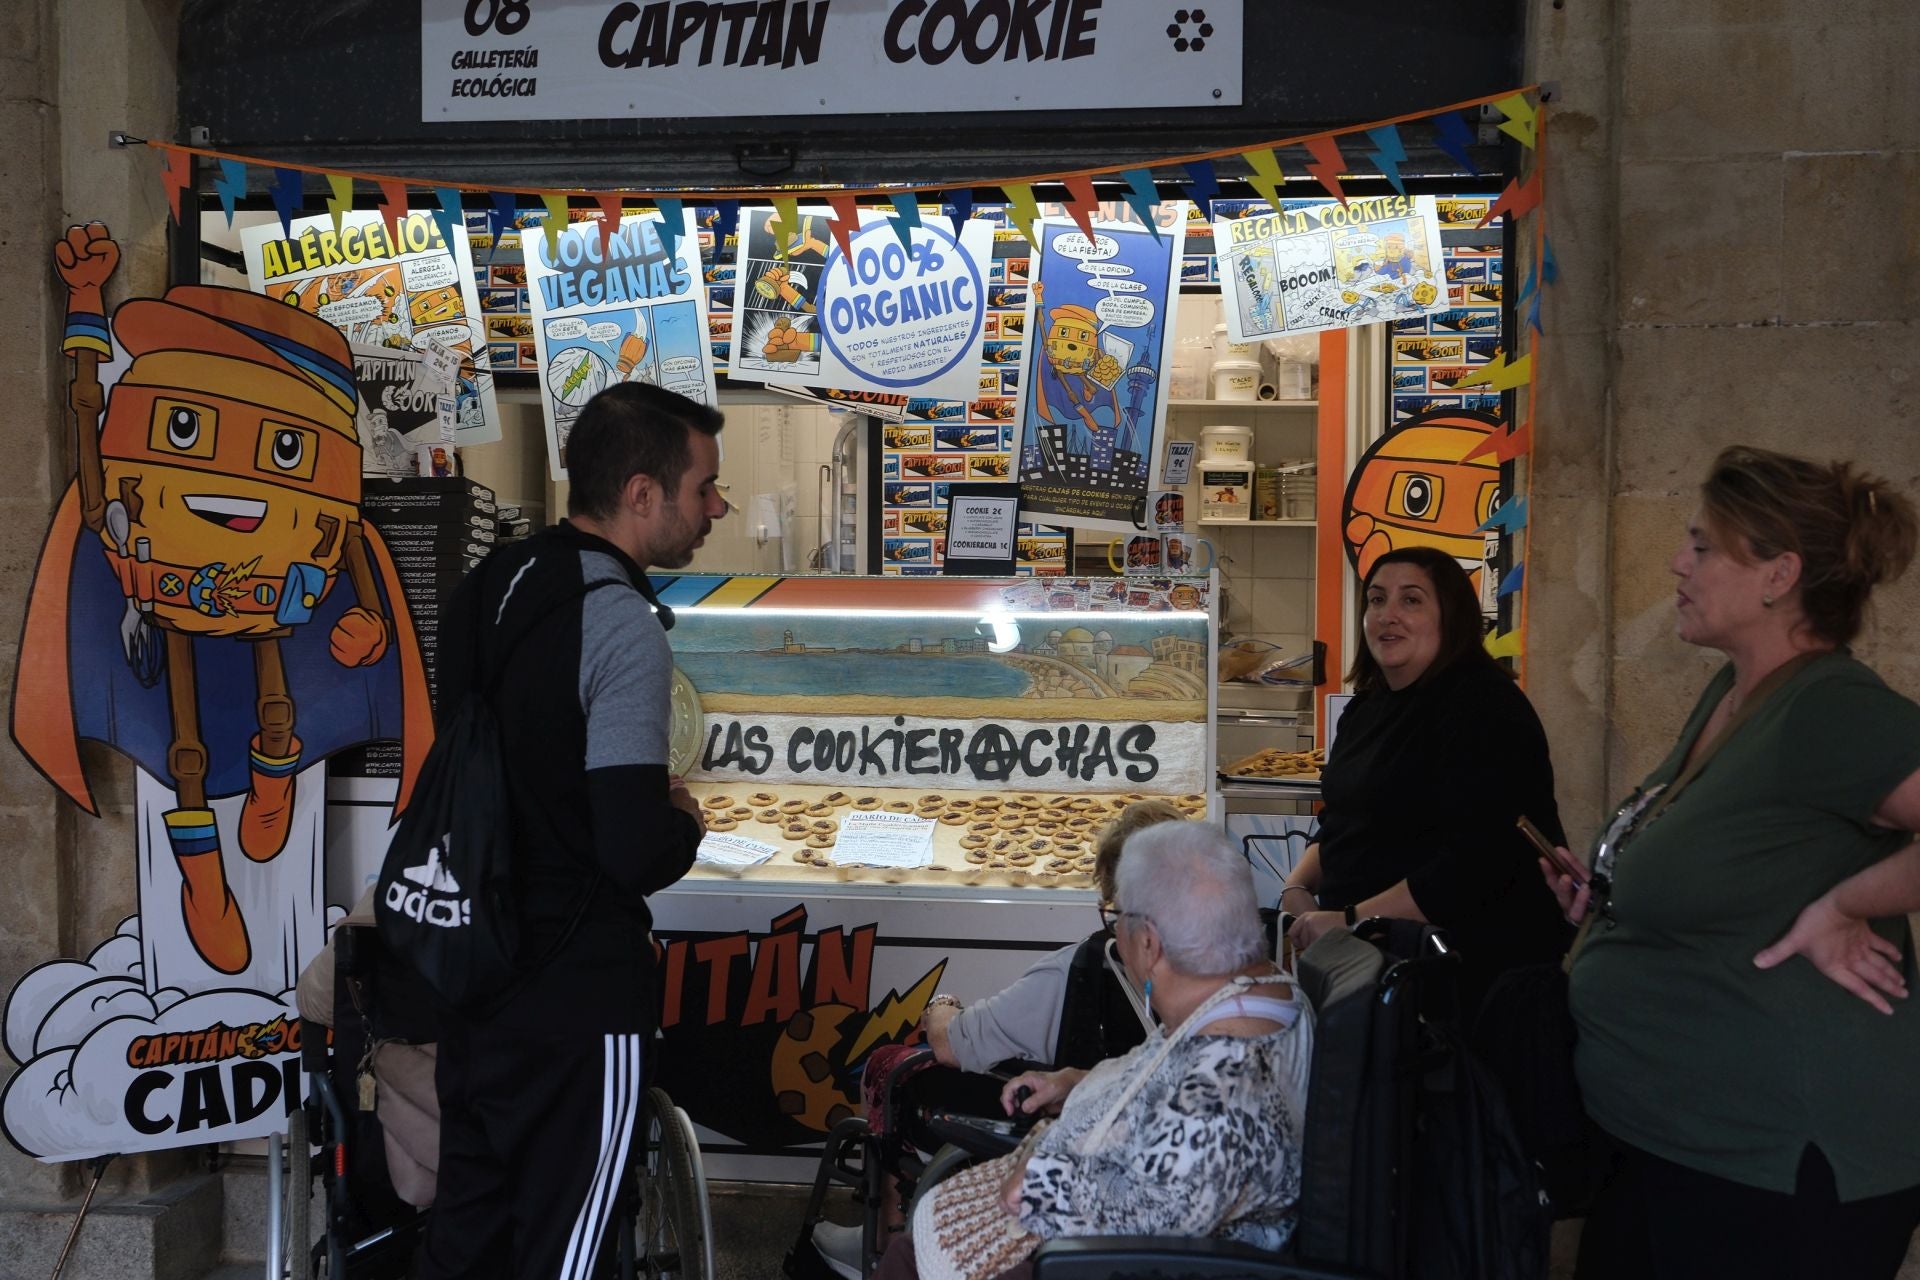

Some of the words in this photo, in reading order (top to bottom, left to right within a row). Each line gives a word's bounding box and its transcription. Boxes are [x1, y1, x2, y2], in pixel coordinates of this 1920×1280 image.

[464, 0, 530, 36] 08
[884, 0, 1102, 65] COOKIE
[451, 45, 538, 70] GALLETERÍA
[451, 73, 536, 98] ECOLÓGICA
[1230, 211, 1309, 244] REGALA
[1320, 196, 1416, 229] COOKIES!
[538, 219, 682, 268] COOKIE
[1080, 246, 1112, 256] FIESTA!
[1087, 237, 1109, 246] ROE
[412, 265, 440, 274] ALERGIA
[842, 239, 944, 288] 100%
[538, 257, 692, 311] VEGANAS
[1280, 266, 1336, 292] BOOOM!
[831, 276, 974, 334] ORGANIC
[1303, 294, 1322, 311] CRACK!
[1320, 306, 1350, 322] CRACK!
[846, 339, 878, 352] TODOS
[880, 332, 916, 344] NUESTROS
[918, 320, 970, 336] INGREDIENTES
[868, 344, 912, 358] TOTALMENTE
[914, 331, 966, 349] NATURALES
[450, 356, 458, 365] 15
[877, 351, 926, 367] RESPETUOSOS
[927, 348, 942, 356] CON
[882, 366, 906, 375] MEDIO
[1171, 446, 1192, 458] TAZA!
[1048, 487, 1070, 495] CAJAS
[1082, 490, 1110, 498] COOKIES
[953, 540, 996, 549] COOKIERACHA
[702, 721, 774, 775] LAS
[652, 903, 878, 1030] ITÁN
[128, 1021, 239, 1069] CAPITÁN
[124, 1057, 310, 1134] CADI
